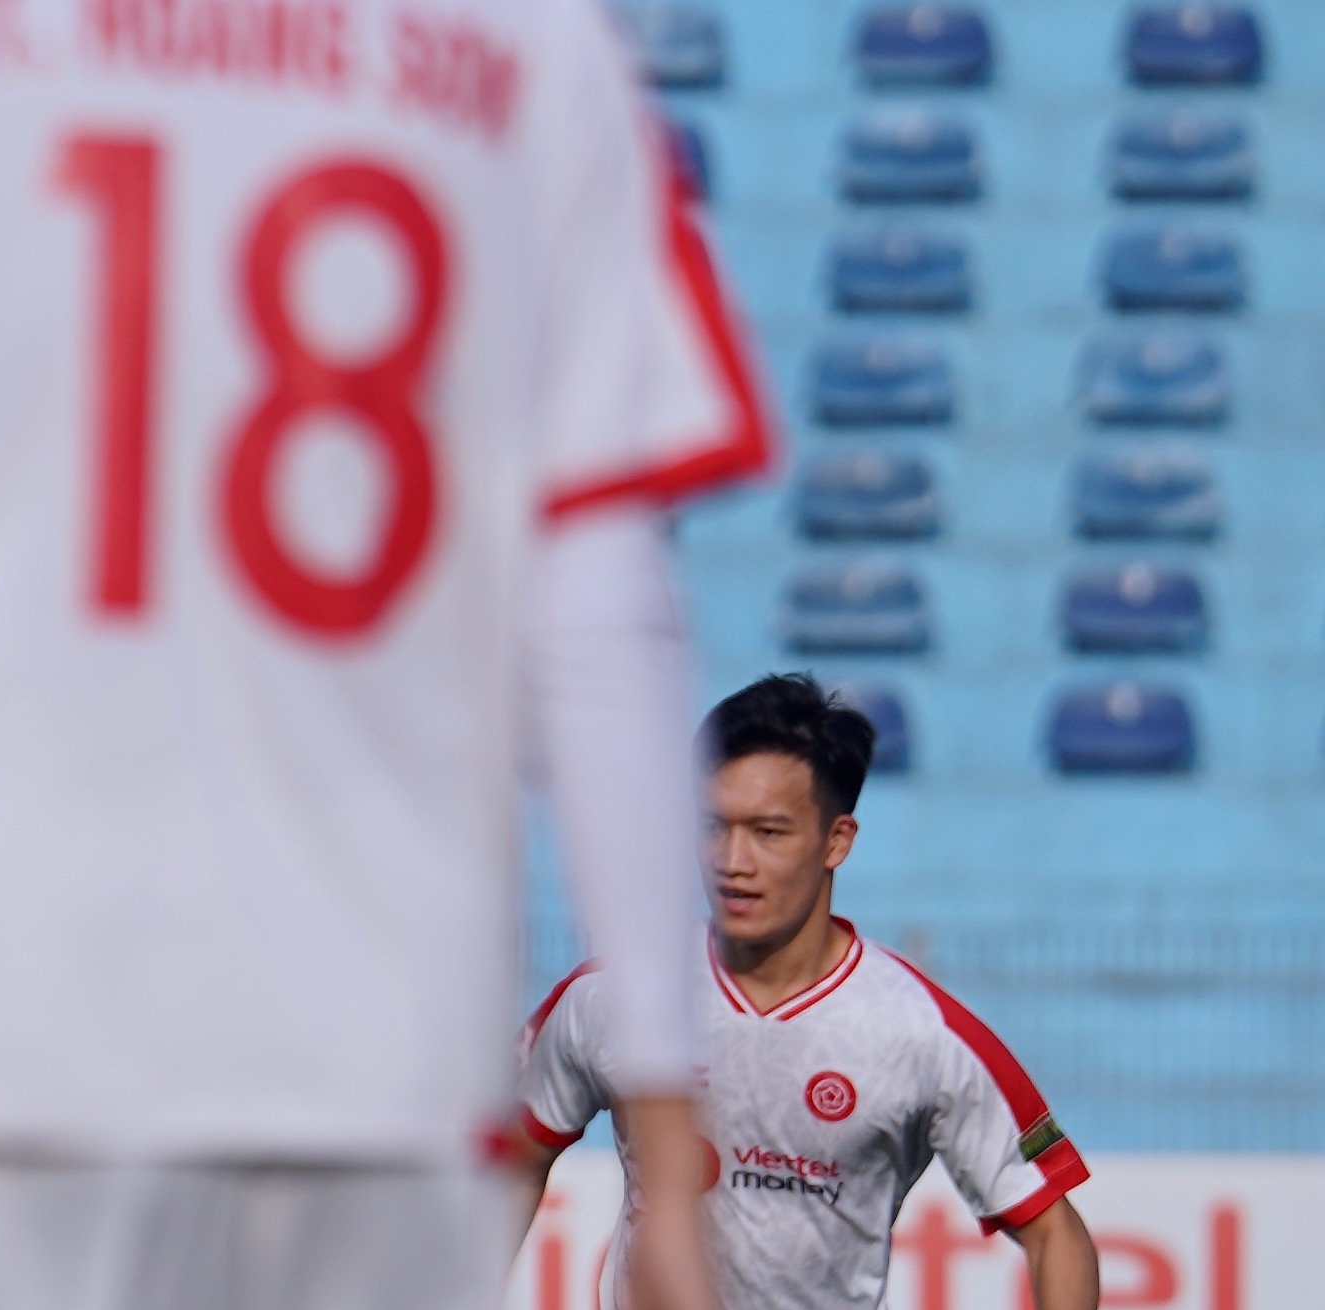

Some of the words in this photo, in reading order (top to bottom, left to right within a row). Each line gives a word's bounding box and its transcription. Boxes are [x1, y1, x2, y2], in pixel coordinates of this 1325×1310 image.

[52, 126, 451, 652] 18
[732, 1145, 841, 1178] viettel
[732, 1169, 845, 1206] money
